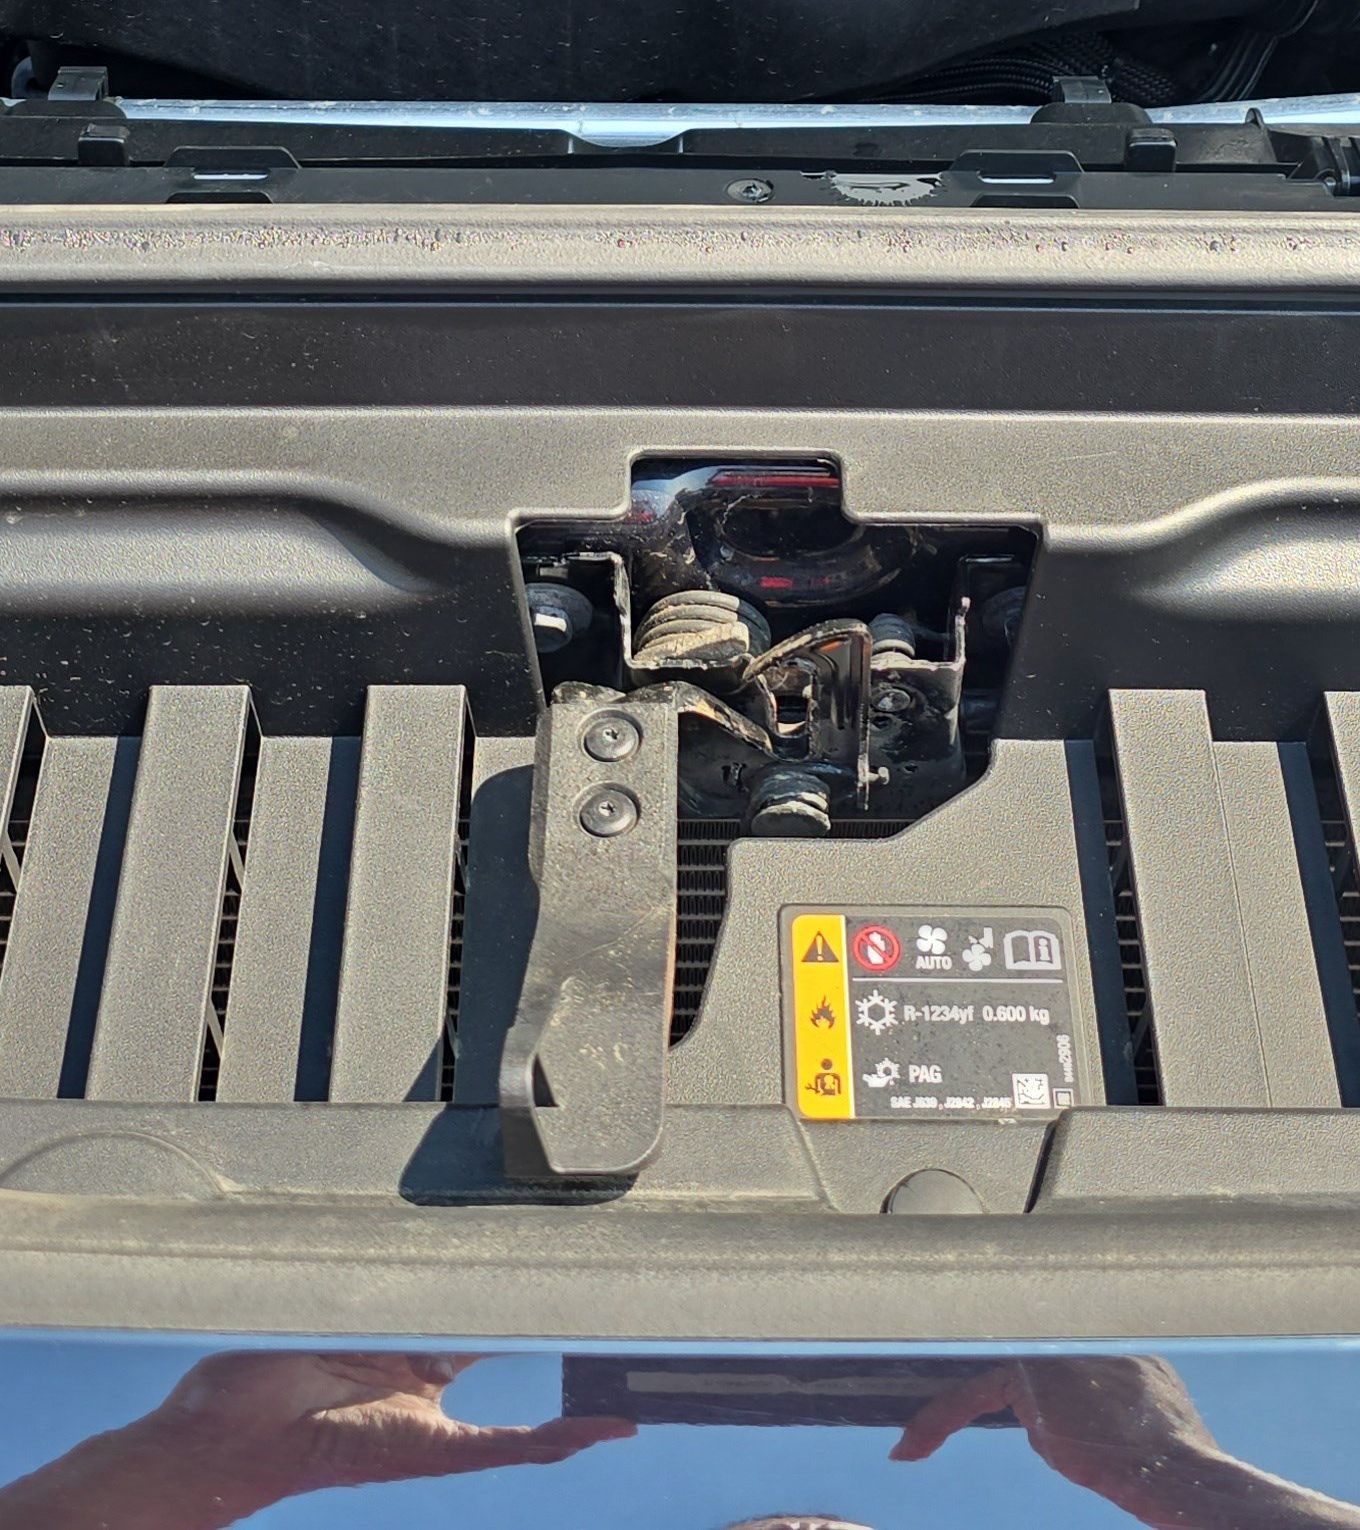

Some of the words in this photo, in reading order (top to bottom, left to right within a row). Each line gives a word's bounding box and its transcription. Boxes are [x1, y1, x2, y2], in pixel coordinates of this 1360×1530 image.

[915, 956, 952, 970] AUTO
[903, 1005, 975, 1025] R-1234yf
[982, 1006, 1026, 1022] 0.600
[1029, 1006, 1050, 1025] kg
[908, 1065, 943, 1084] PAG
